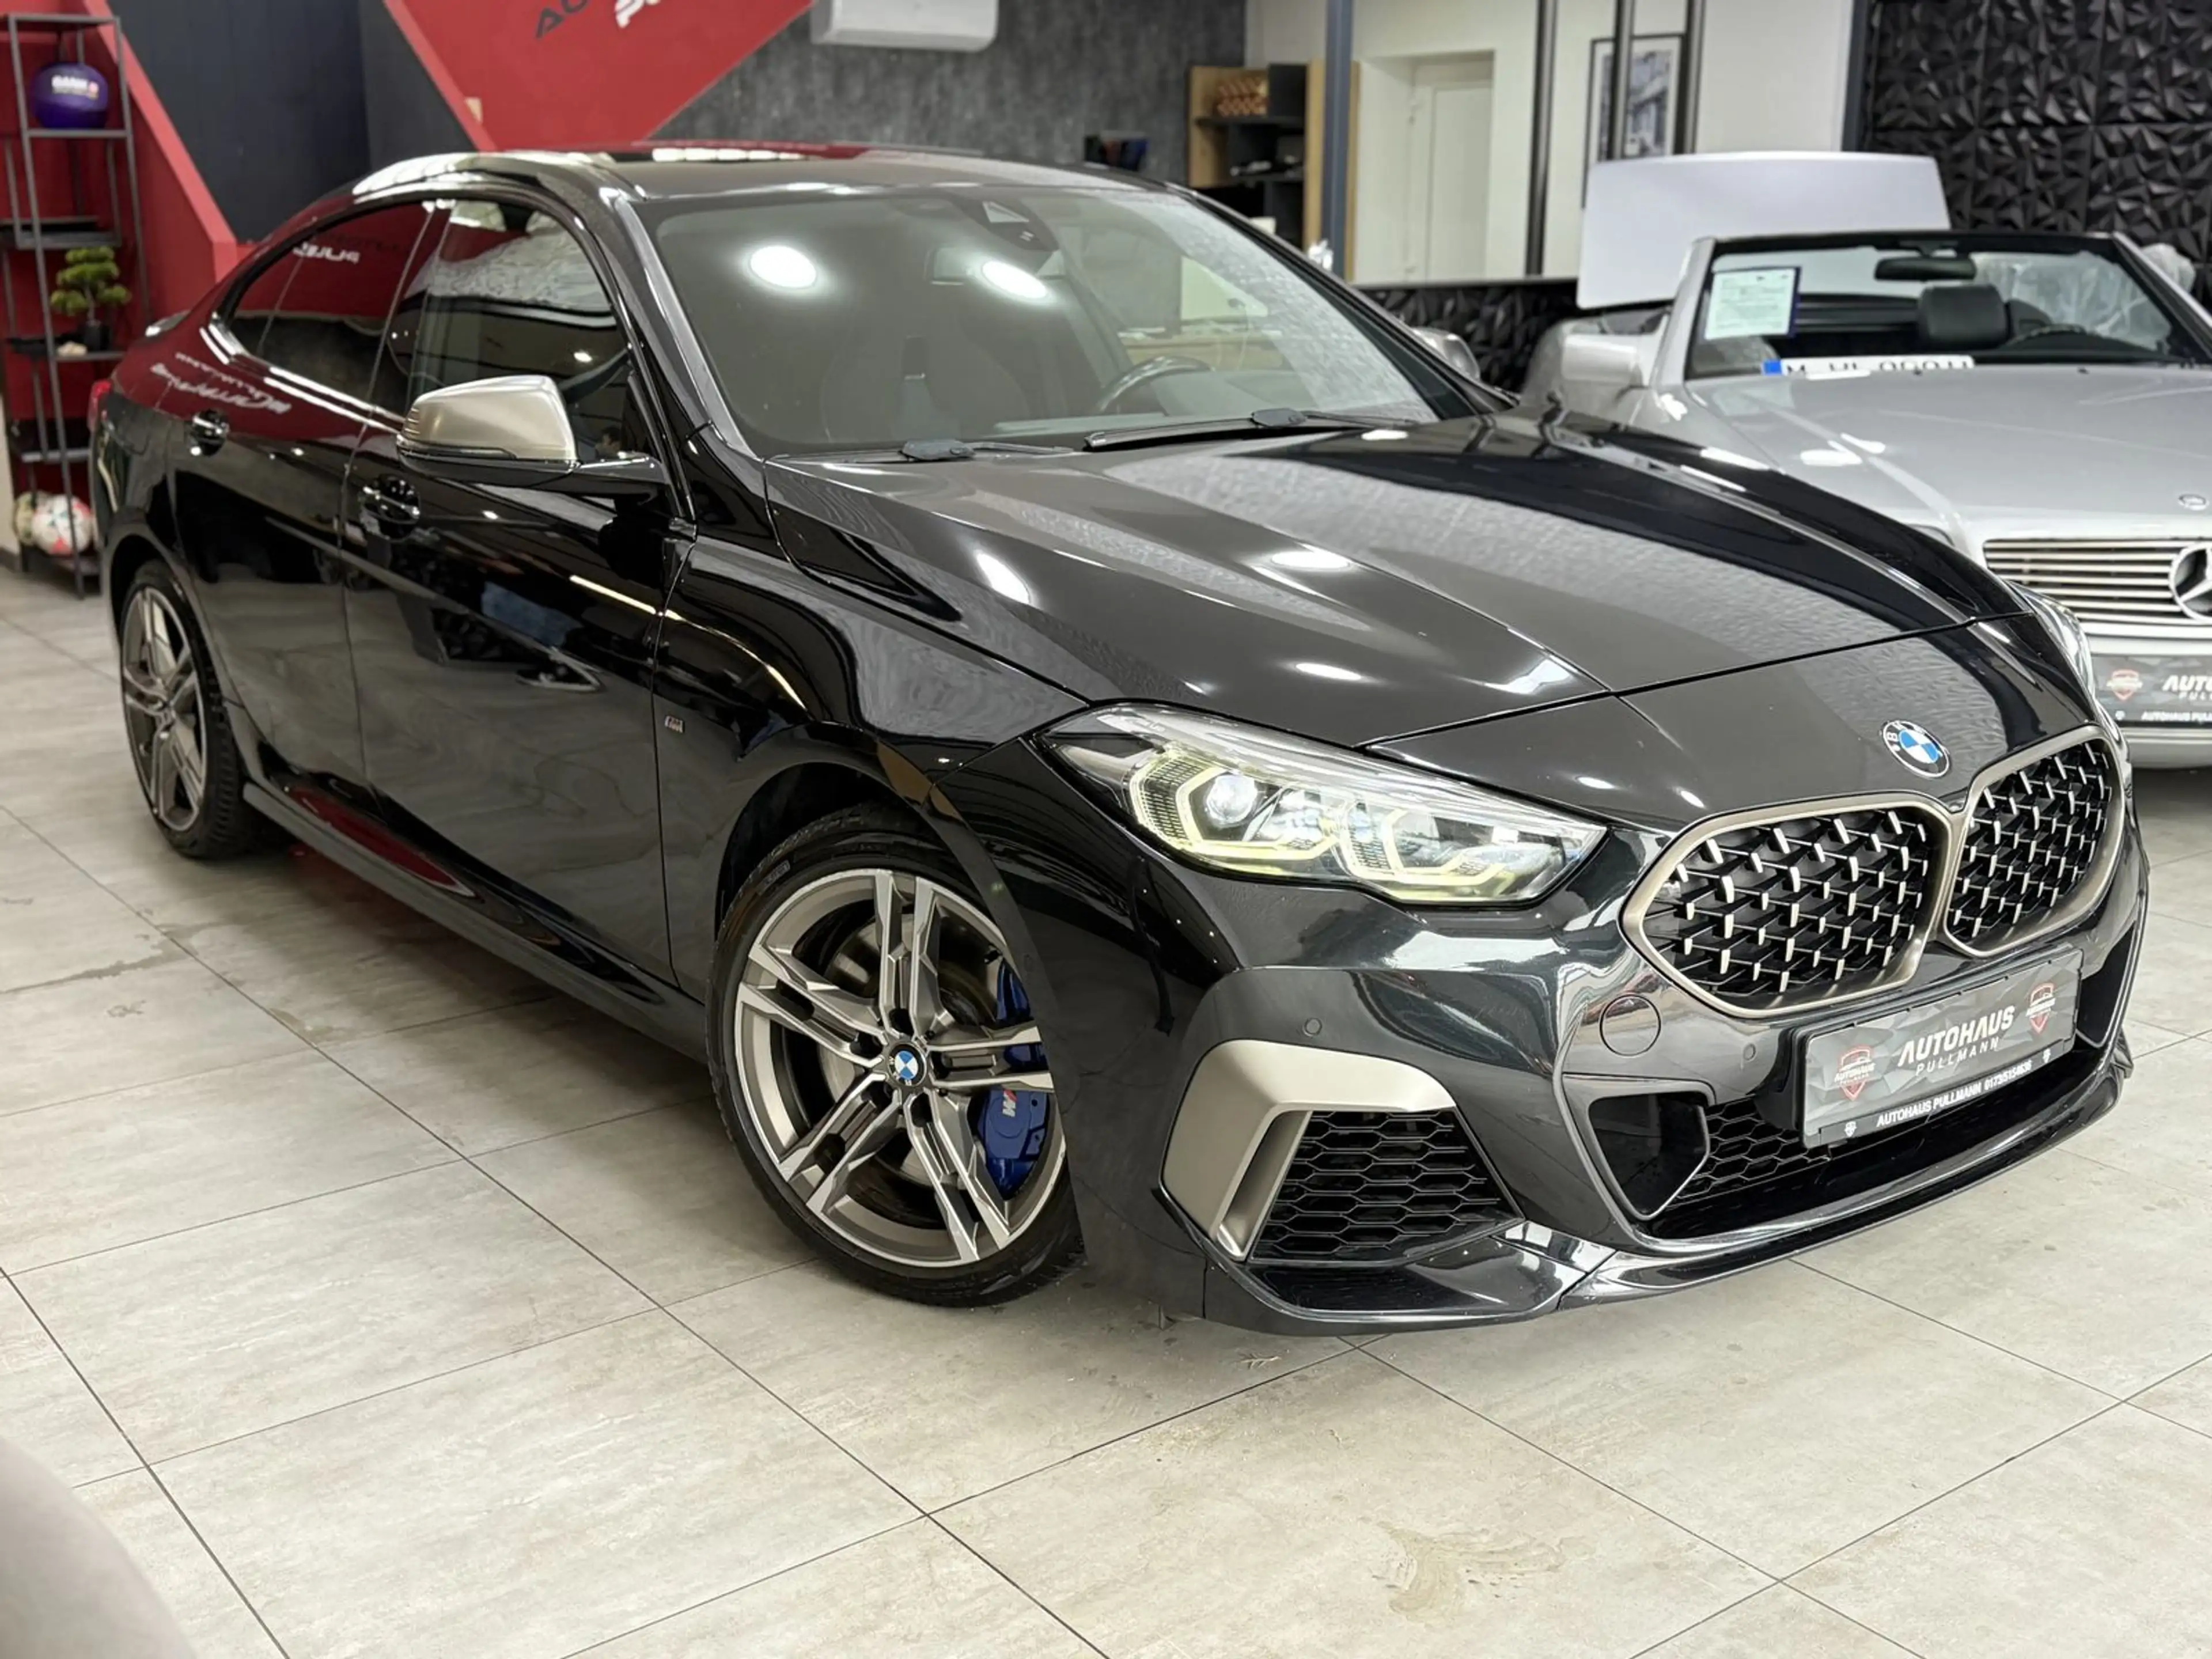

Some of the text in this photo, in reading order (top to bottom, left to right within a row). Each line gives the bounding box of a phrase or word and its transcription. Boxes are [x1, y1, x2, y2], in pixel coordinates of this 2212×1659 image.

[1897, 1005, 2016, 1067] AUTOHAUS
[1915, 1036, 1999, 1076] PULLMANN
[1876, 1100, 1932, 1127] AUTOHAUS
